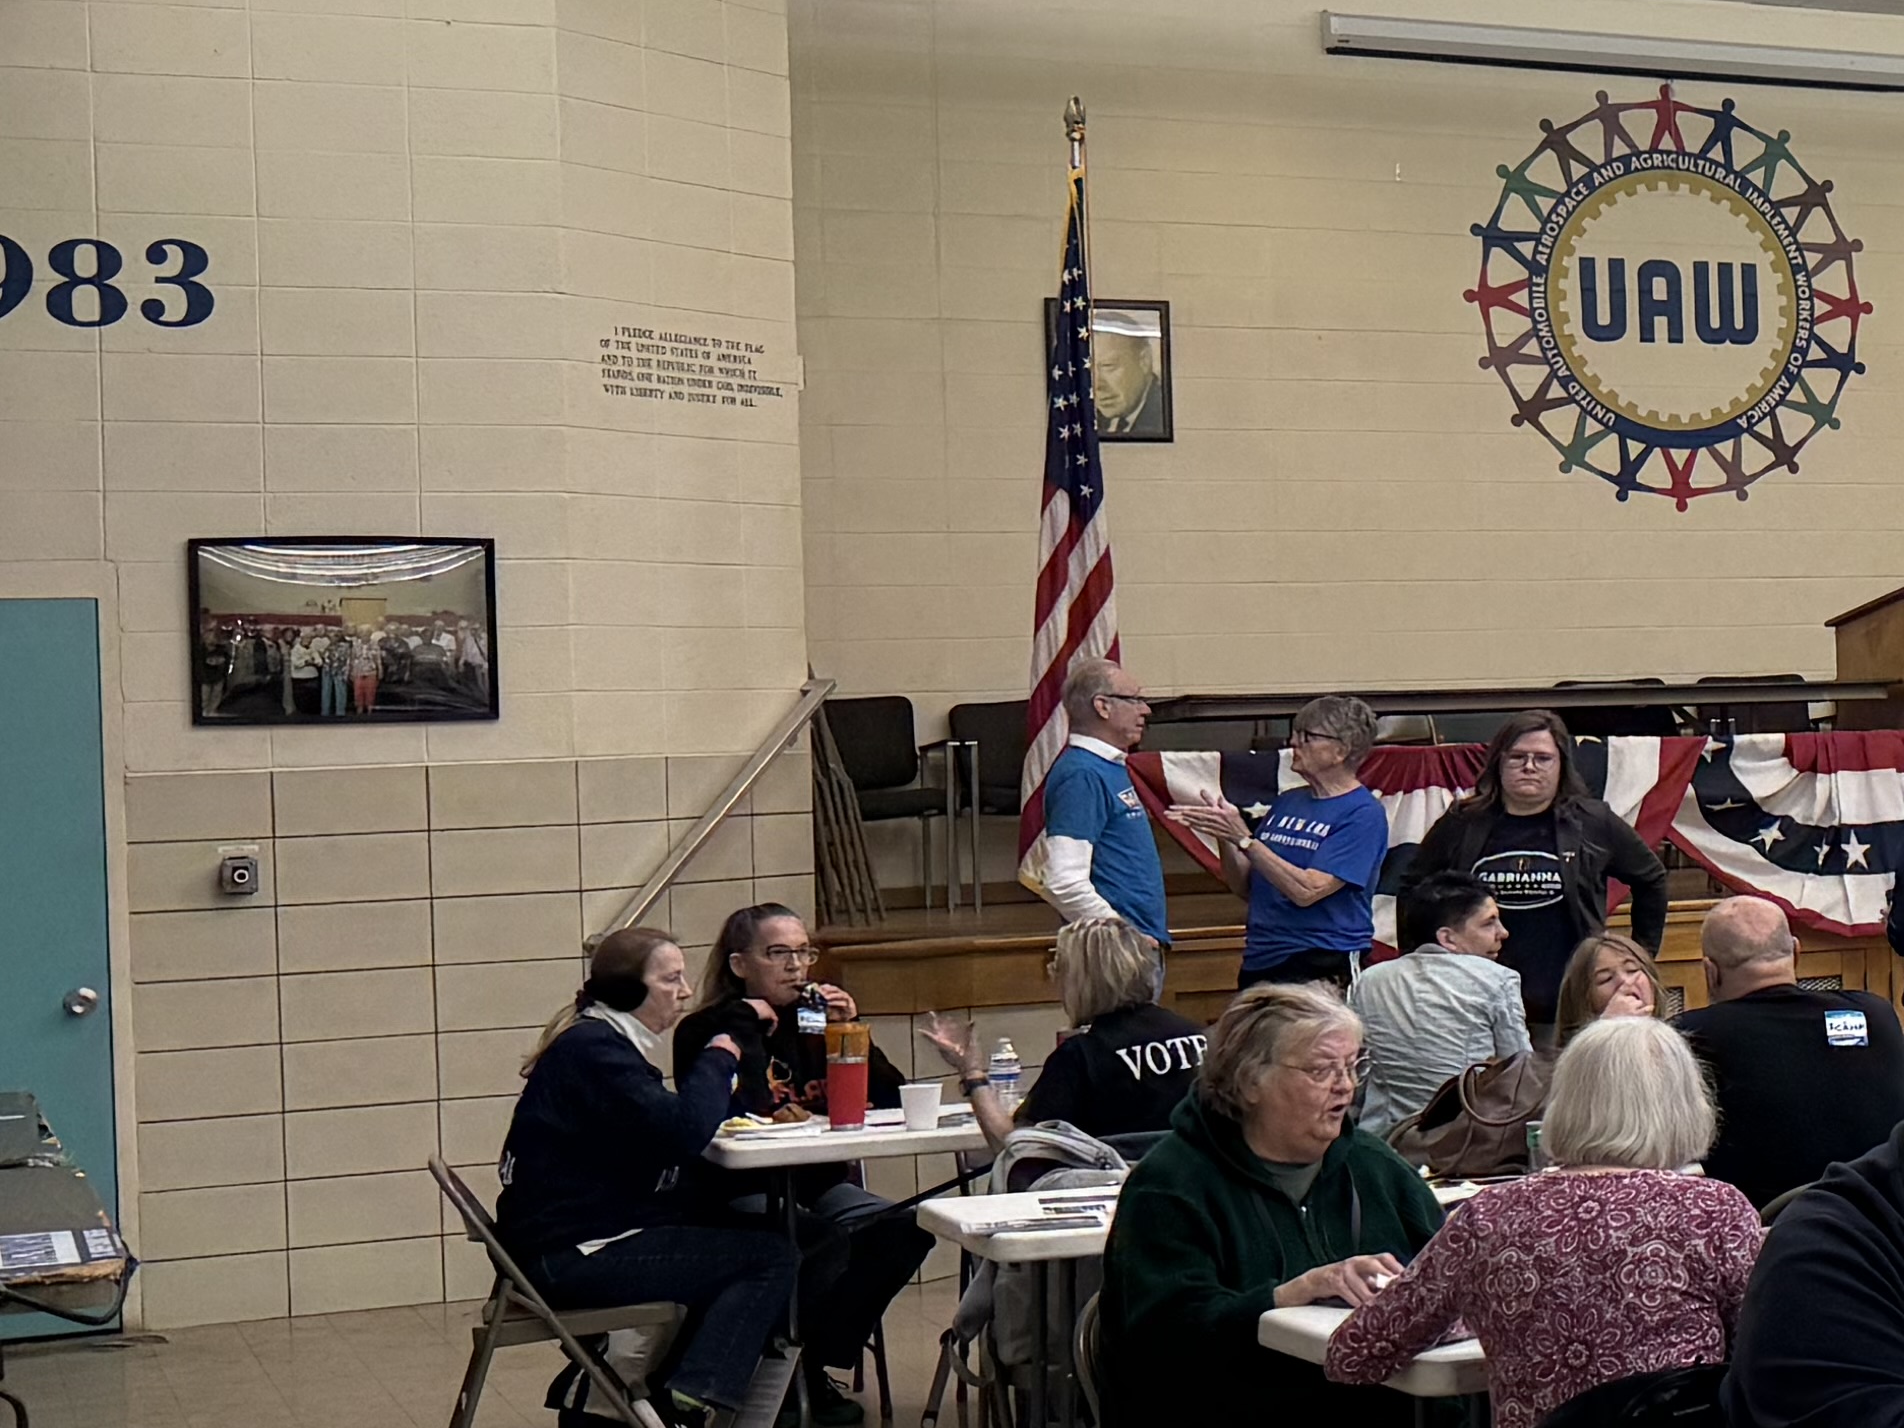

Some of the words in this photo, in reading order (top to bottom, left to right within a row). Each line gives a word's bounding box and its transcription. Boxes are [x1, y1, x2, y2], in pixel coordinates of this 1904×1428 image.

[1592, 161, 1625, 187] AND
[1630, 152, 1742, 192] AGRICULTURAL
[1535, 182, 1590, 266] AEROSPACE
[1745, 186, 1803, 266] IMPLEMENT
[1579, 257, 1760, 346] UAW
[1795, 271, 1811, 349] WORKERS
[712, 338, 722, 349] TO
[1787, 352, 1802, 376] OF
[1568, 381, 1617, 427] UNITED
[1737, 374, 1790, 430] AMERICA
